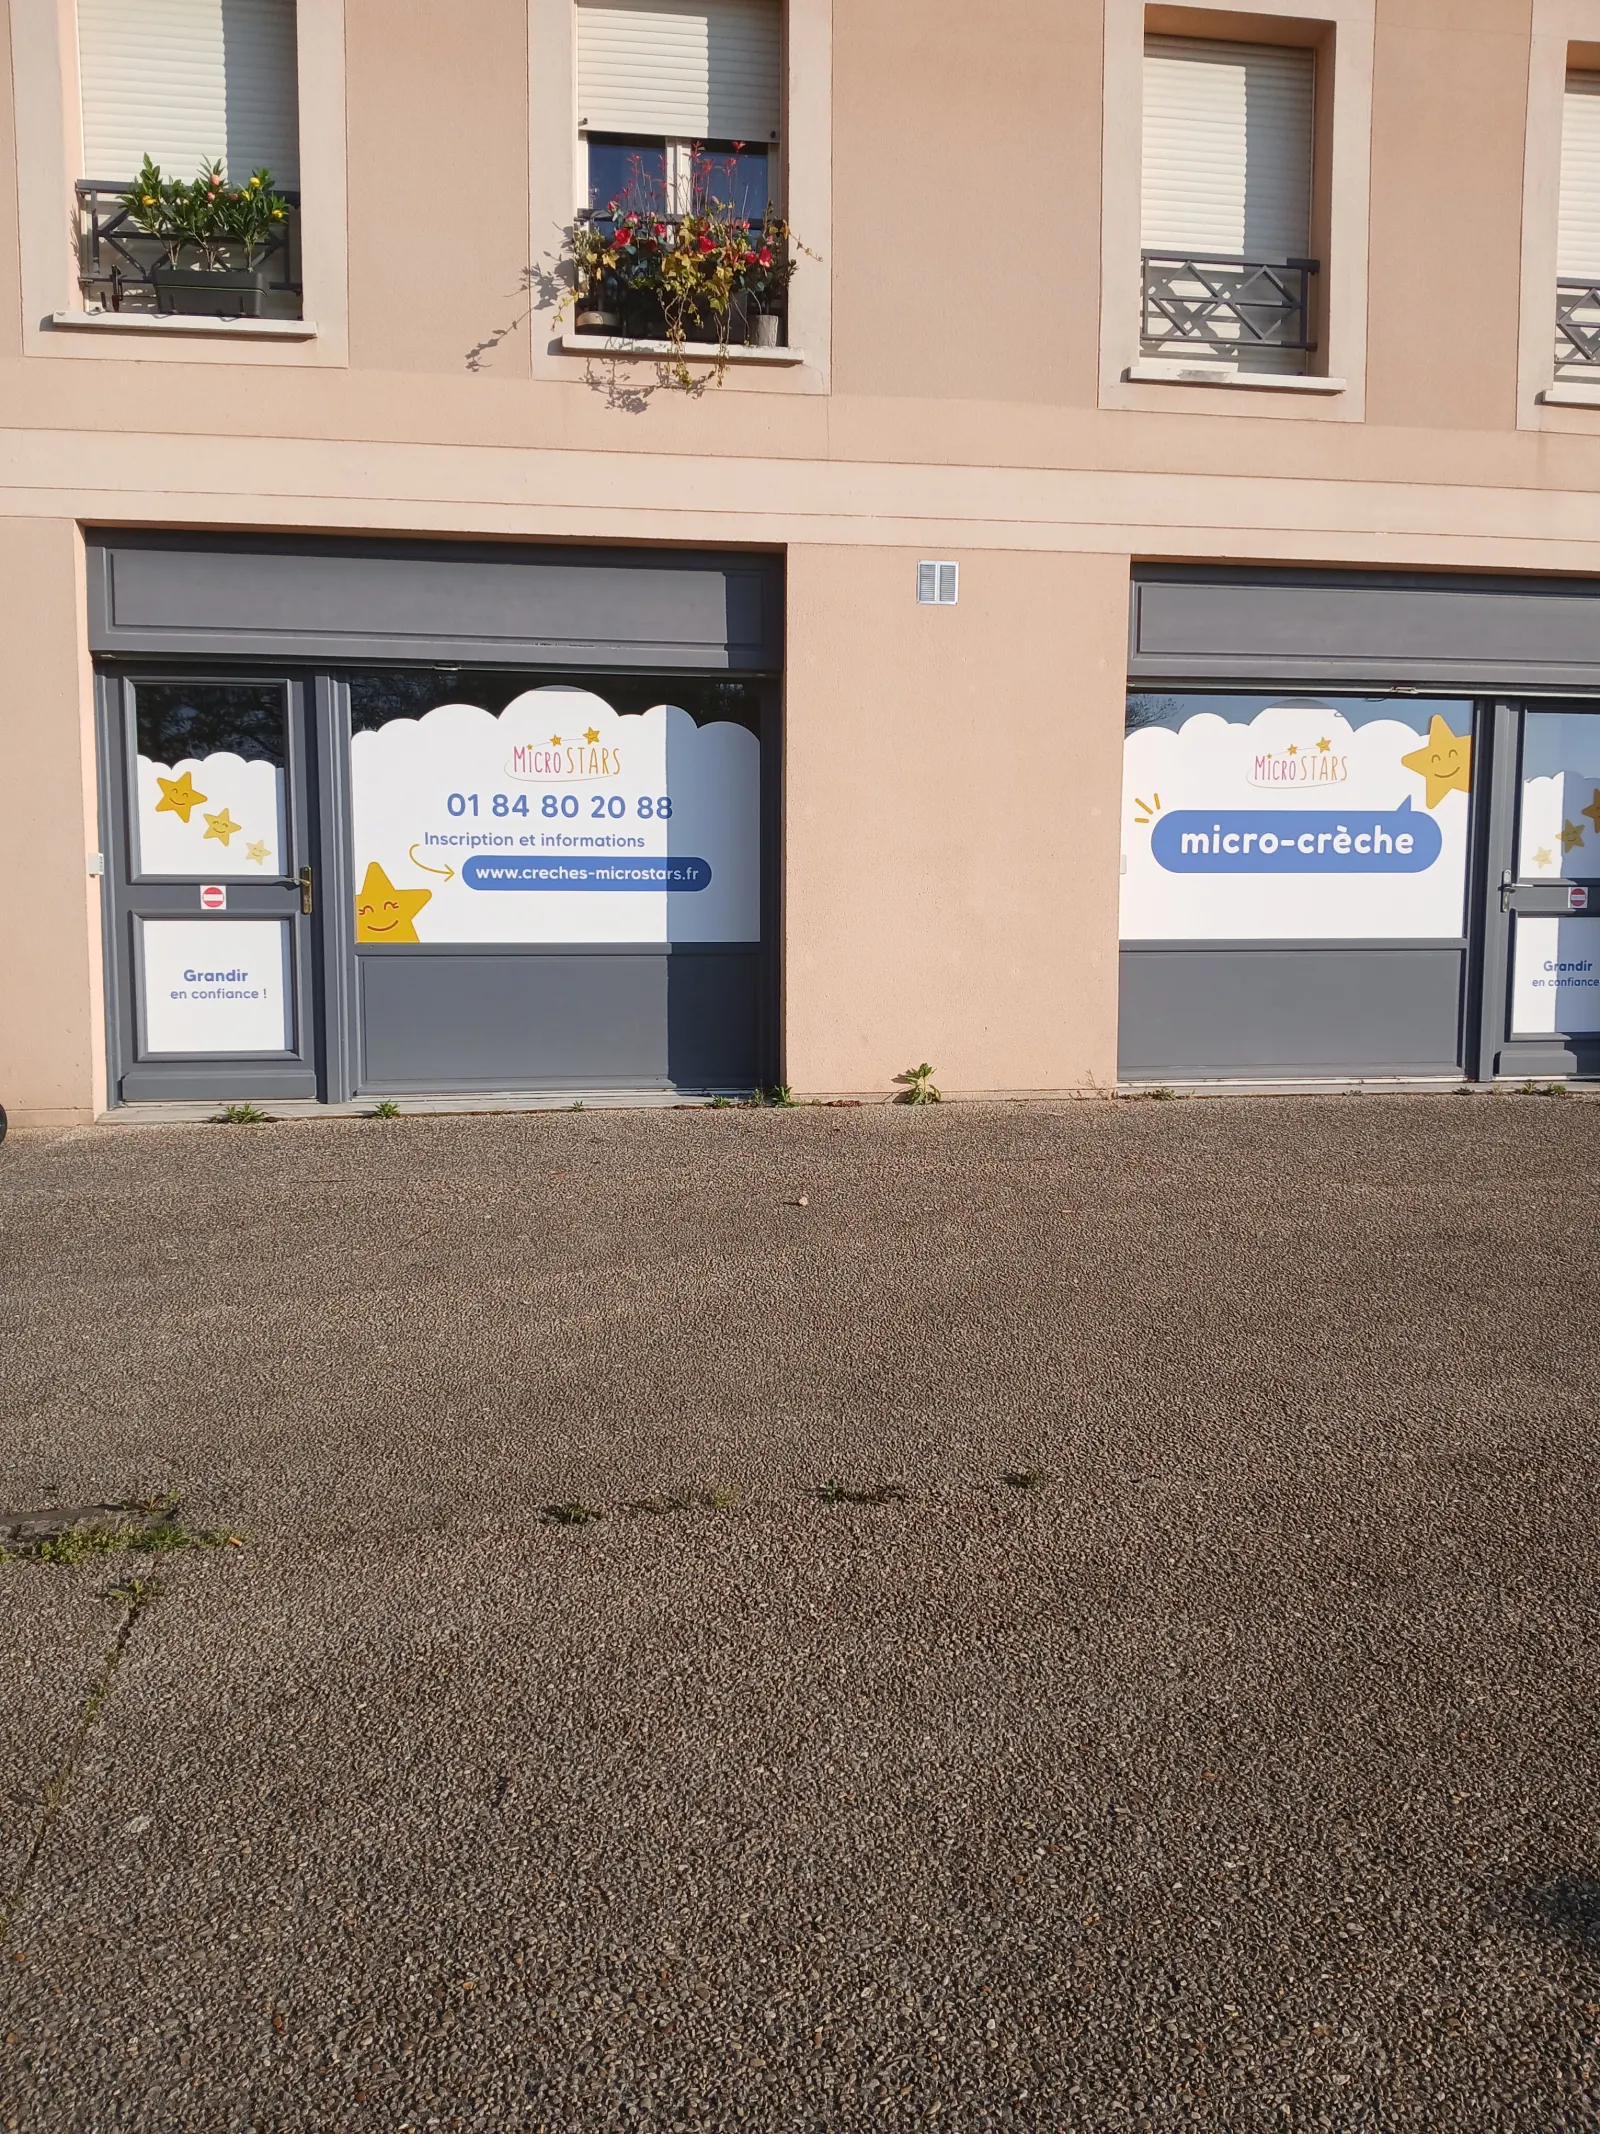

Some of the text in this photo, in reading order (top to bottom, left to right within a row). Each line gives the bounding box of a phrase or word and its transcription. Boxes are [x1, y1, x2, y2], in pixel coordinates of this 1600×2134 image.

[447, 793, 674, 820] 01 84 80 20 88
[424, 832, 646, 850] Inscription et informations
[1181, 824, 1415, 855] micro-crèche
[475, 865, 700, 883] www.creches-microstars.fr
[1543, 960, 1593, 972] Grandir
[183, 969, 249, 982] Grandir
[1532, 977, 1600, 987] en confiance
[170, 990, 187, 999] en
[191, 988, 259, 999] confiance
